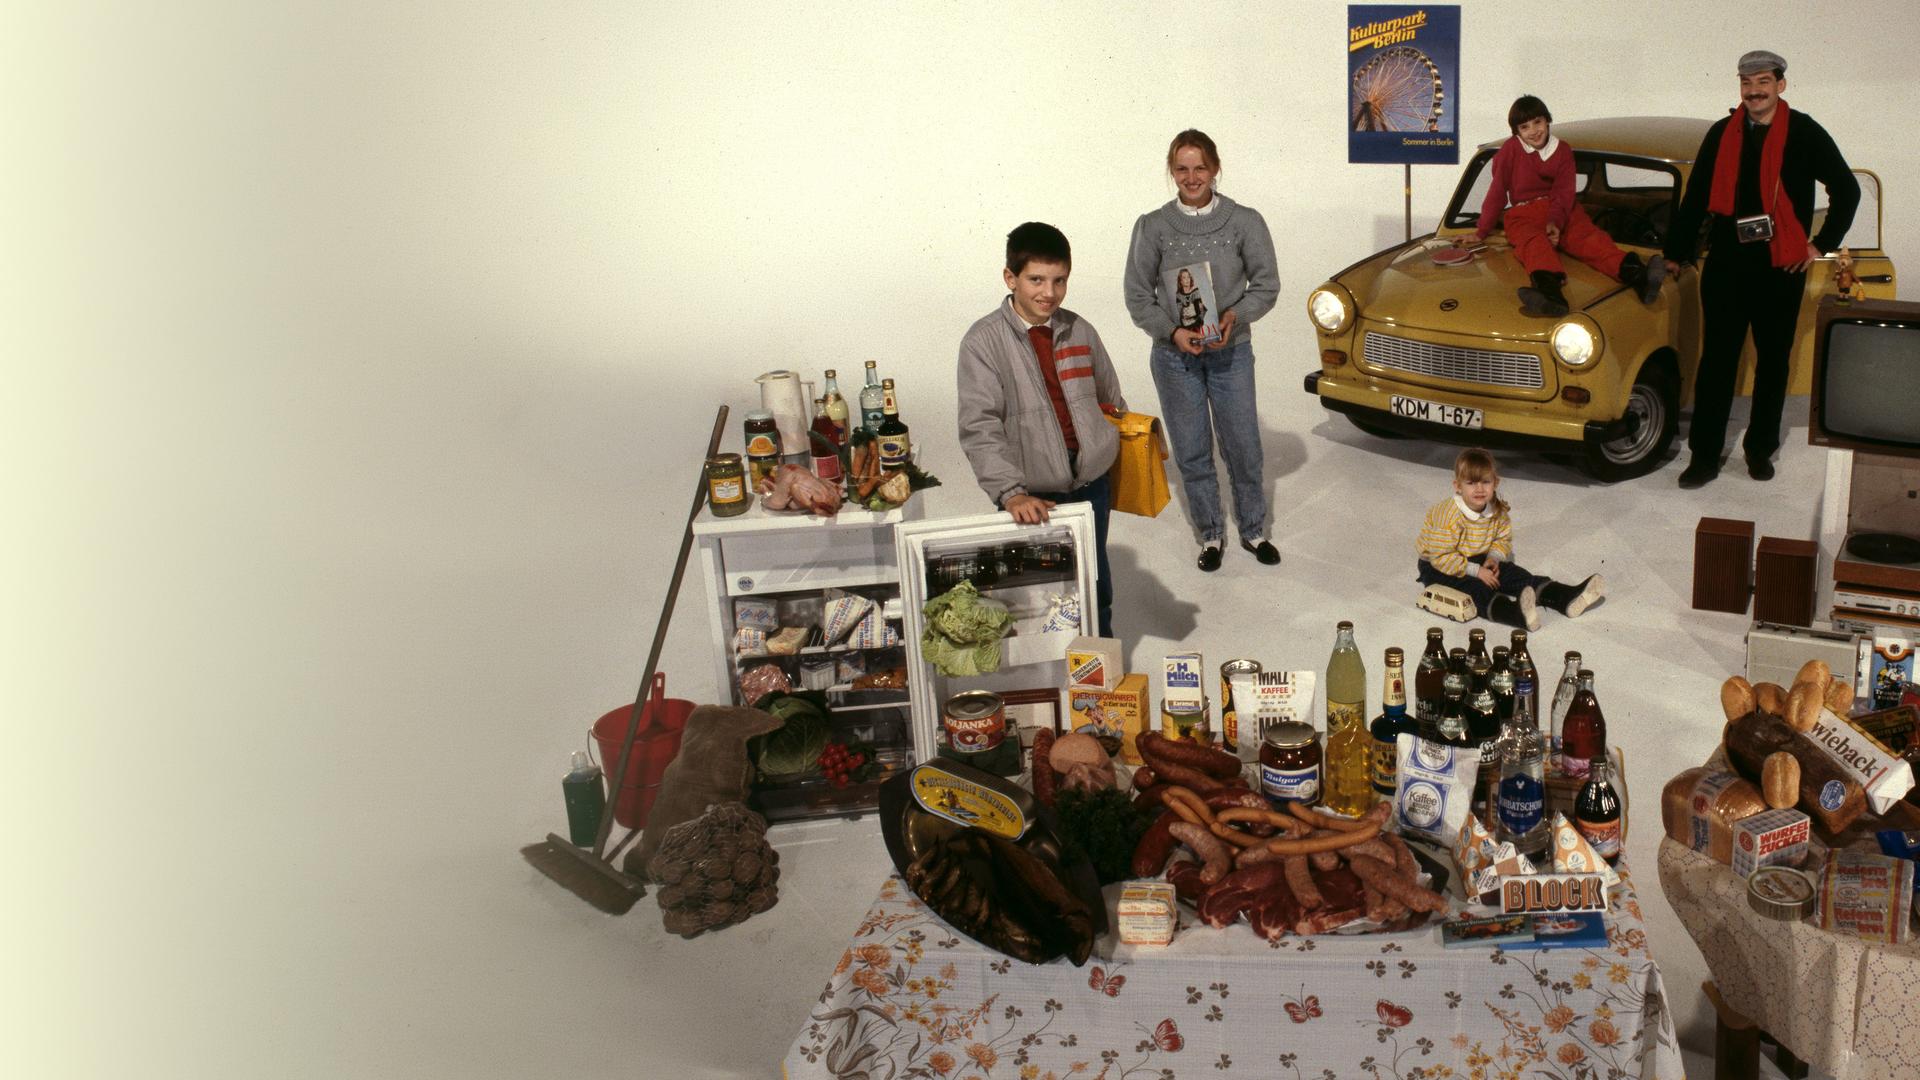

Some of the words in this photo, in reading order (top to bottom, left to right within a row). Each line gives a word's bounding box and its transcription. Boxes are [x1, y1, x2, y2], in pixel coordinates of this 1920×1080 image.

[1350, 10, 1427, 42] Kulturpark
[1373, 28, 1416, 49] Berlin
[1402, 137, 1428, 146] Sommer
[1430, 137, 1436, 146] in
[1436, 137, 1454, 146] Berlin
[1396, 397, 1430, 420] KDM
[1438, 405, 1475, 427] 1-67
[1167, 671, 1199, 681] Milch
[1177, 662, 1188, 672] H
[1261, 686, 1289, 695] KAFFEE
[1810, 721, 1879, 778] wieback
[1409, 791, 1438, 806] Kaffee
[1759, 831, 1808, 857] ZUCKER
[1503, 876, 1606, 914] BLOCK
